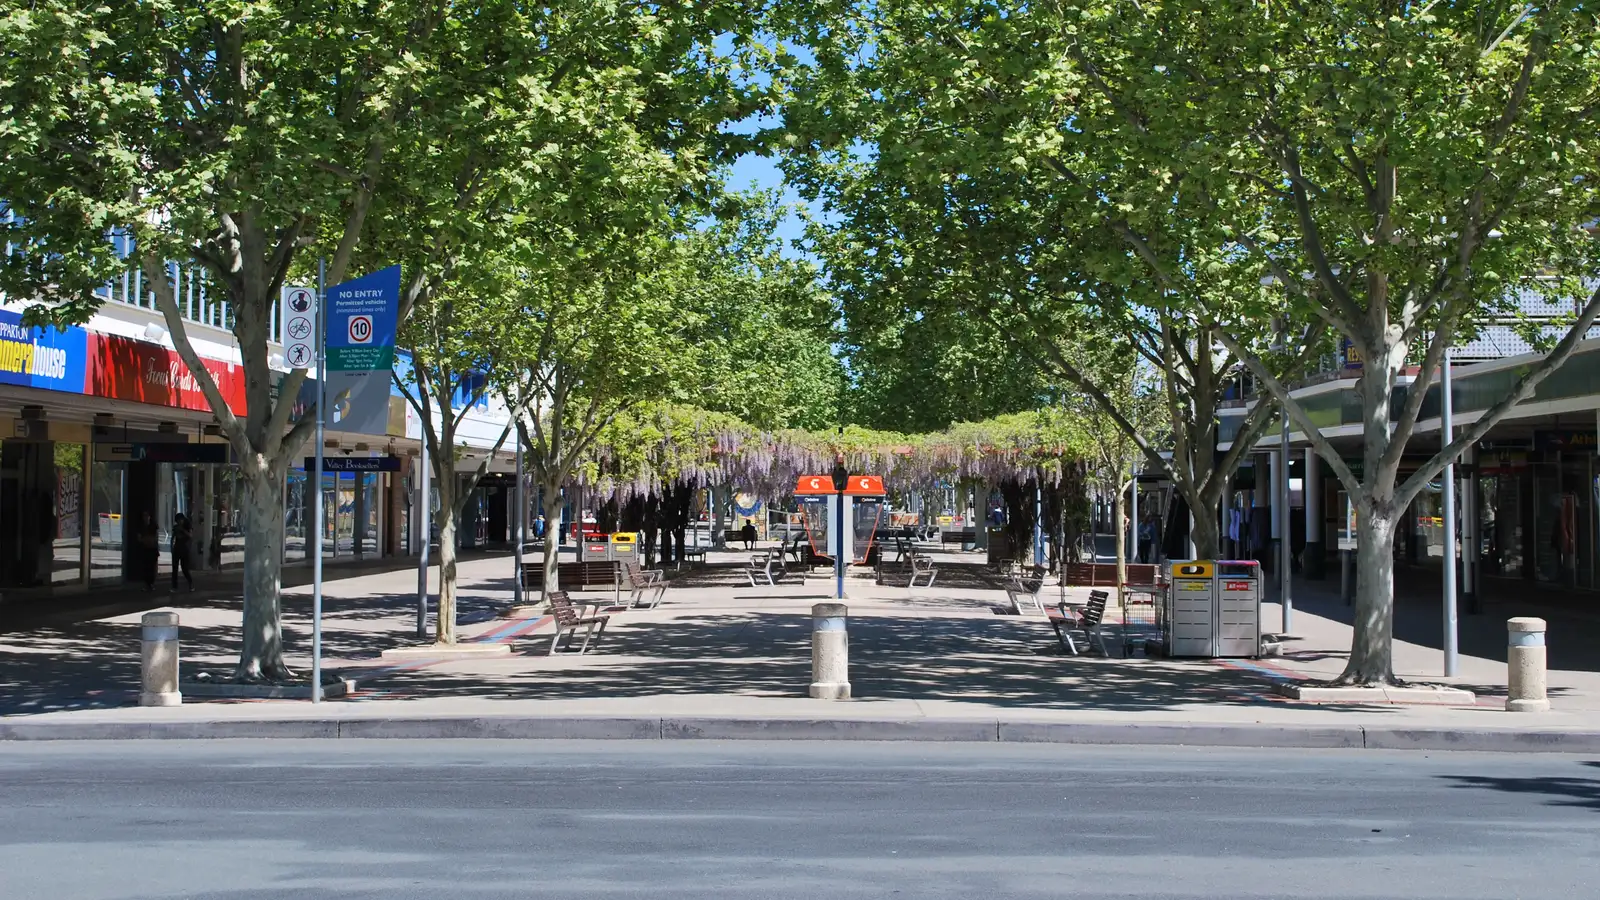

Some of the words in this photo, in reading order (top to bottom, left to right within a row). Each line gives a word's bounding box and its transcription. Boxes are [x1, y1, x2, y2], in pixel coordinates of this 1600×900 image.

[354, 323, 367, 335] 10
[326, 459, 343, 469] Valley
[346, 459, 380, 469] Booksellers
